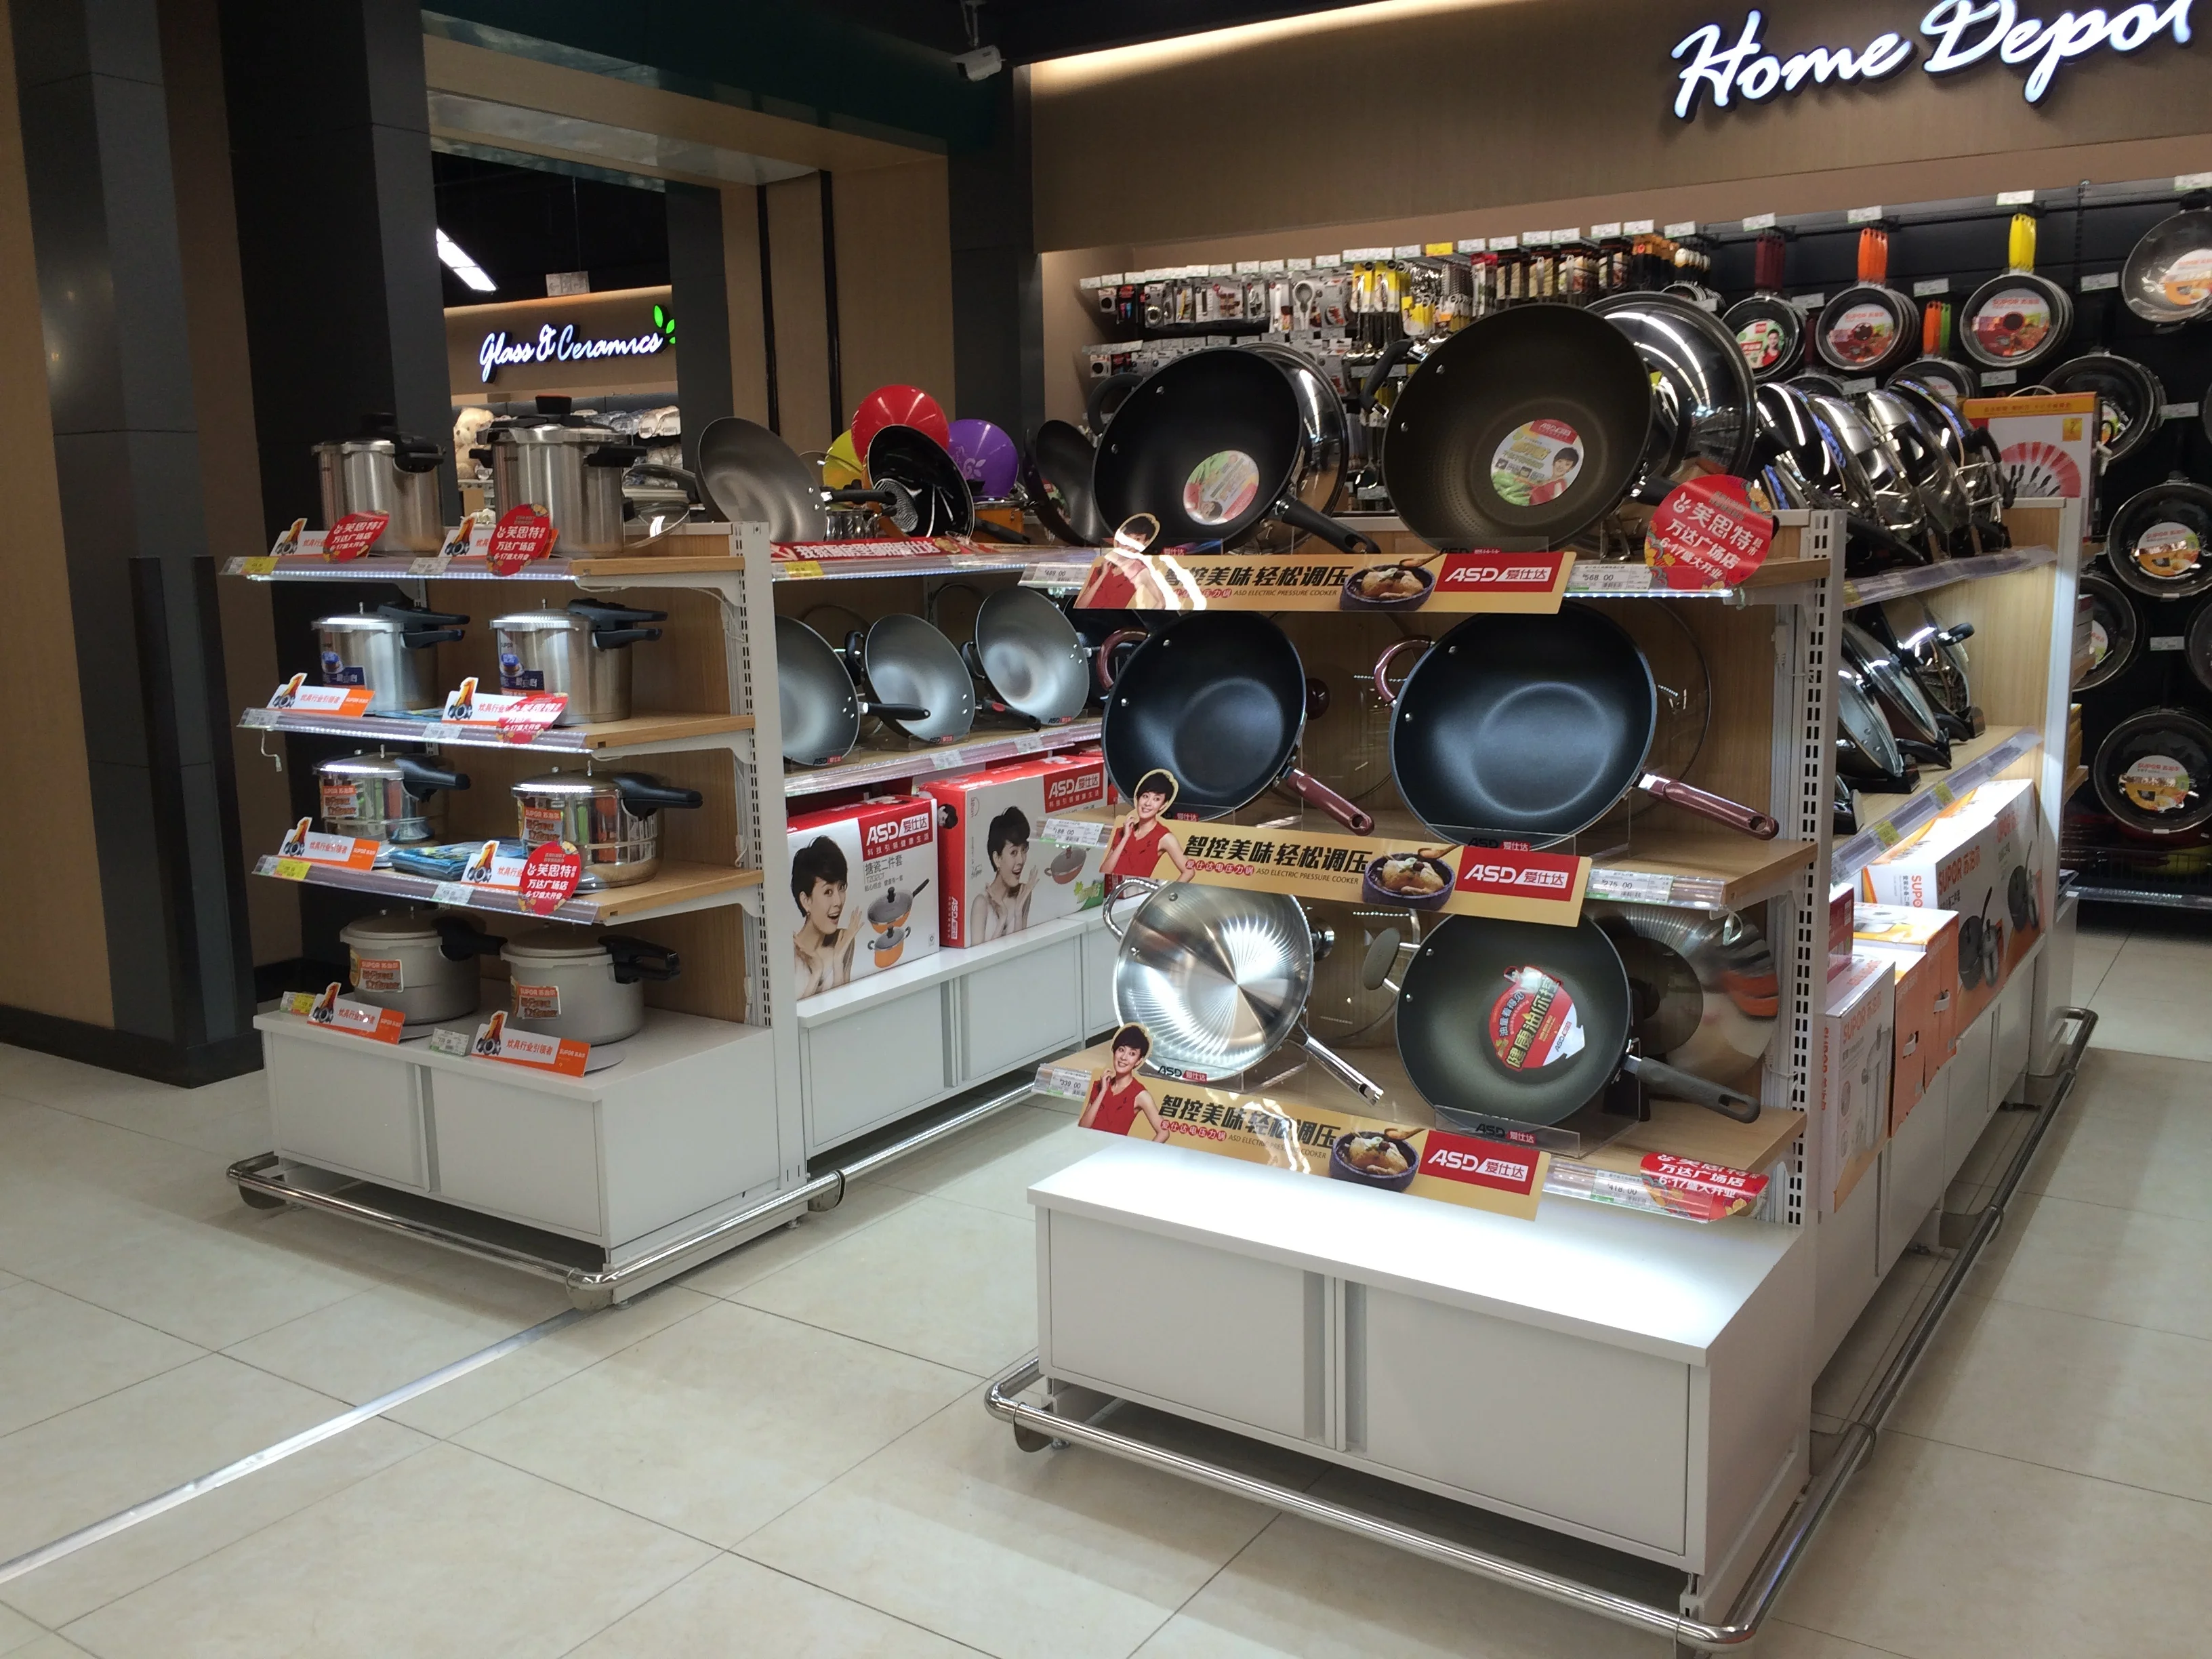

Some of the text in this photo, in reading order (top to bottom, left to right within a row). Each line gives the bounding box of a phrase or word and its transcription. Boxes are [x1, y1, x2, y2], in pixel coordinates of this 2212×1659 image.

[1670, 9, 1911, 119] Home
[479, 331, 534, 382] Glass
[557, 324, 663, 361] Ceramics
[496, 541, 537, 552] 万达广场店
[1665, 518, 1741, 570] 万达广场店
[1445, 567, 1550, 582] ASD 爱仕达
[1048, 775, 1099, 799] ASD 爱仕达
[866, 817, 927, 846] ASD 爱仕达
[867, 832, 929, 857] 科技引领健康生活
[1183, 835, 1373, 874] 智控美味轻松调压
[1185, 860, 1254, 876] 爱仕达电压力锅
[1256, 867, 1359, 884] ASD ELECTRIC PRESSURE COOKER
[1464, 865, 1565, 889] ASD 爱仕达
[1938, 854, 1963, 895] SUPOR
[527, 879, 569, 890] 万达广场店
[1843, 1007, 1866, 1044] SUPOR
[506, 1038, 553, 1056] 炊具行业引领者
[1555, 1036, 1565, 1052] ASD
[1157, 1065, 1206, 1082] ASD 爱仕达
[1160, 1120, 1227, 1142] 爱仕达电压力锅
[1475, 1123, 1535, 1143] ASD 爱仕达
[1301, 1149, 1327, 1159] COOKER
[1427, 1149, 1527, 1181] ASD 爱仕达
[1659, 1163, 1746, 1187] 万达广场店
